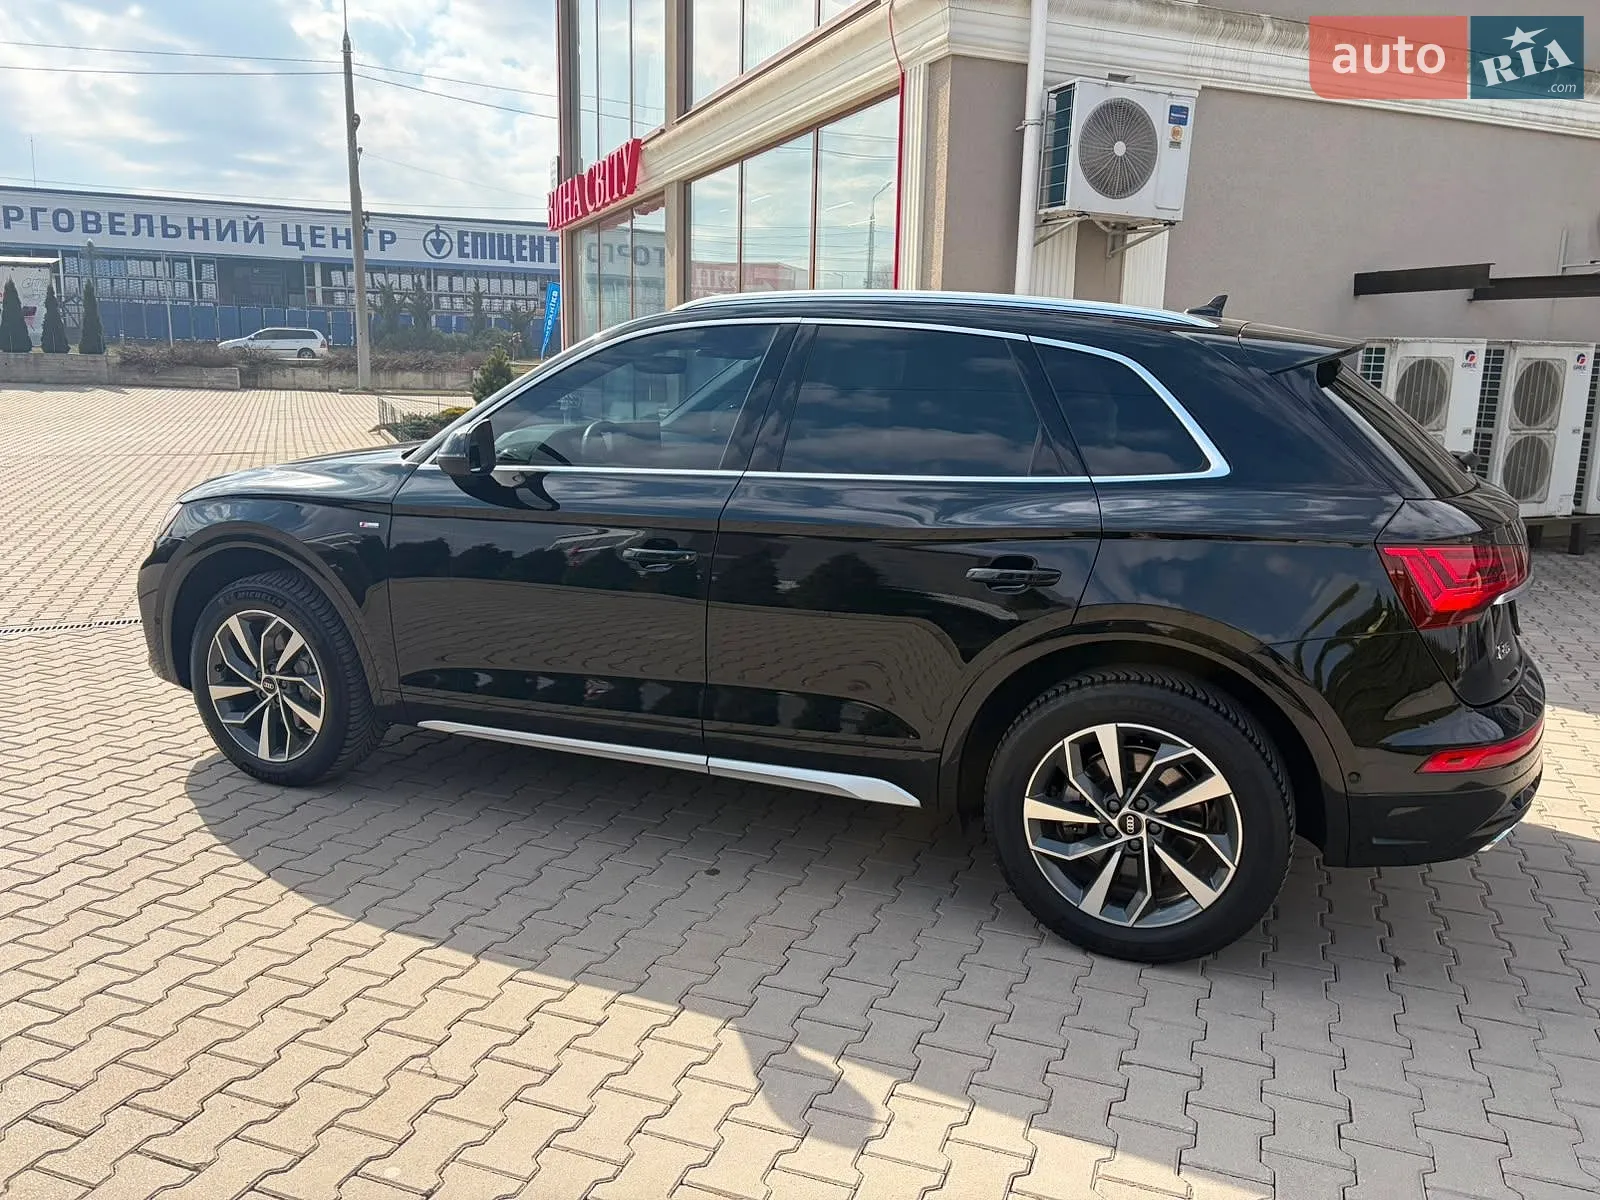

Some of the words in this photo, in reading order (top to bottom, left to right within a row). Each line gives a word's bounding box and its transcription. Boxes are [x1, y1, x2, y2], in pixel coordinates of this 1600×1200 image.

[546, 175, 584, 233] ВИНА
[584, 138, 643, 213] СВІТУ
[1, 204, 266, 245] РГОВЕЛЬНИЙ
[457, 230, 560, 264] ЕПІЦЕНТ
